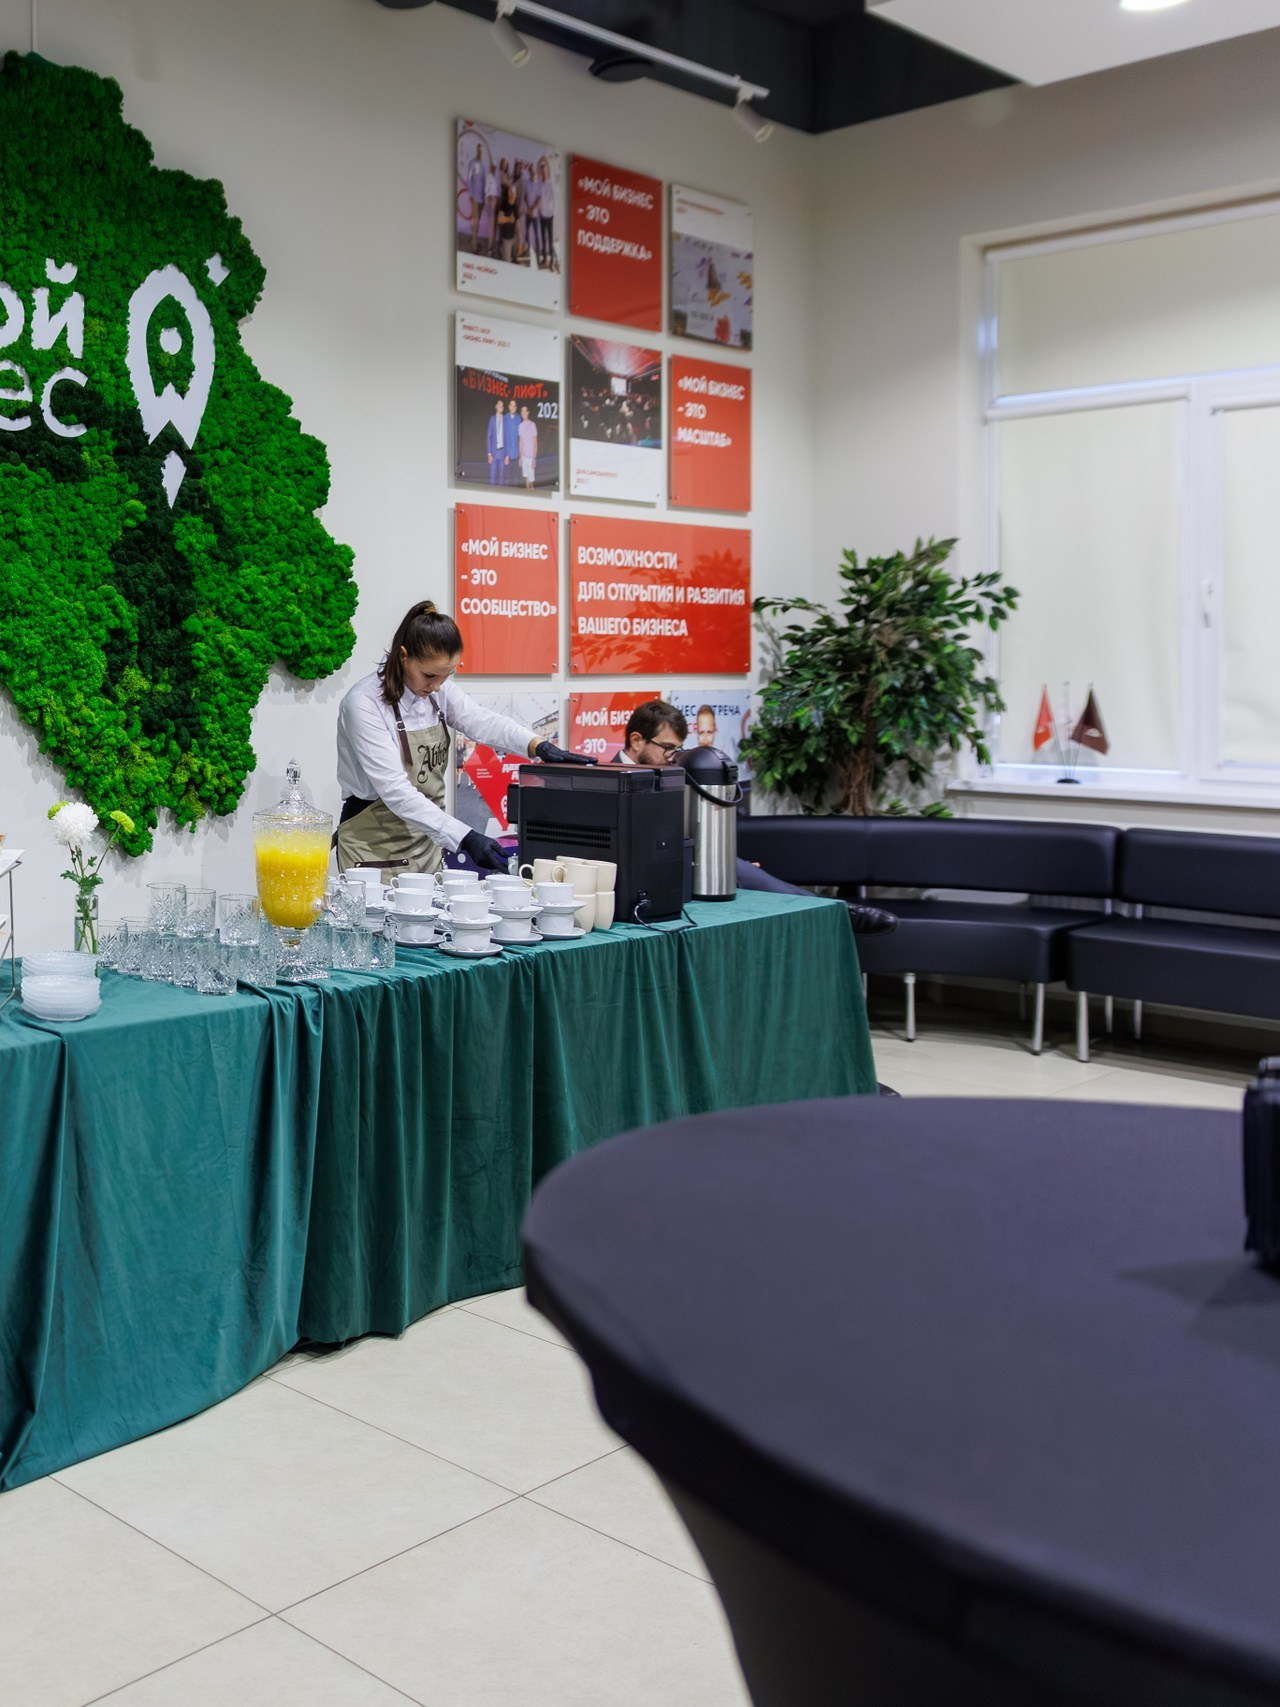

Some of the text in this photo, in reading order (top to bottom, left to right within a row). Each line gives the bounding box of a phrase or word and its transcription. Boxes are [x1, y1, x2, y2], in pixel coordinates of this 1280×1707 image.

[612, 184, 654, 210] БИЗНЕС
[586, 205, 610, 224] ЭТО
[577, 229, 652, 261] ПОДДЕРЖКА»
[708, 381, 745, 400] БИЗНЕС
[685, 402, 707, 420] ЭТО
[677, 427, 732, 448] МАСШТАБ»
[461, 536, 548, 560] «МОЙ БИЗНЕС
[578, 546, 678, 570] ВОЗМОЖНОСТИ
[470, 568, 498, 586] ЭТО
[578, 581, 745, 605] ДЛЯ ОТКРЫТИЯ И РАЗВИТИЯ
[461, 598, 557, 618] СООБЩЕСТВО»
[578, 617, 688, 636] ВАШЕГО БИЗНЕСА
[575, 707, 608, 727] «МОЙ
[583, 738, 607, 754] ЭТО
